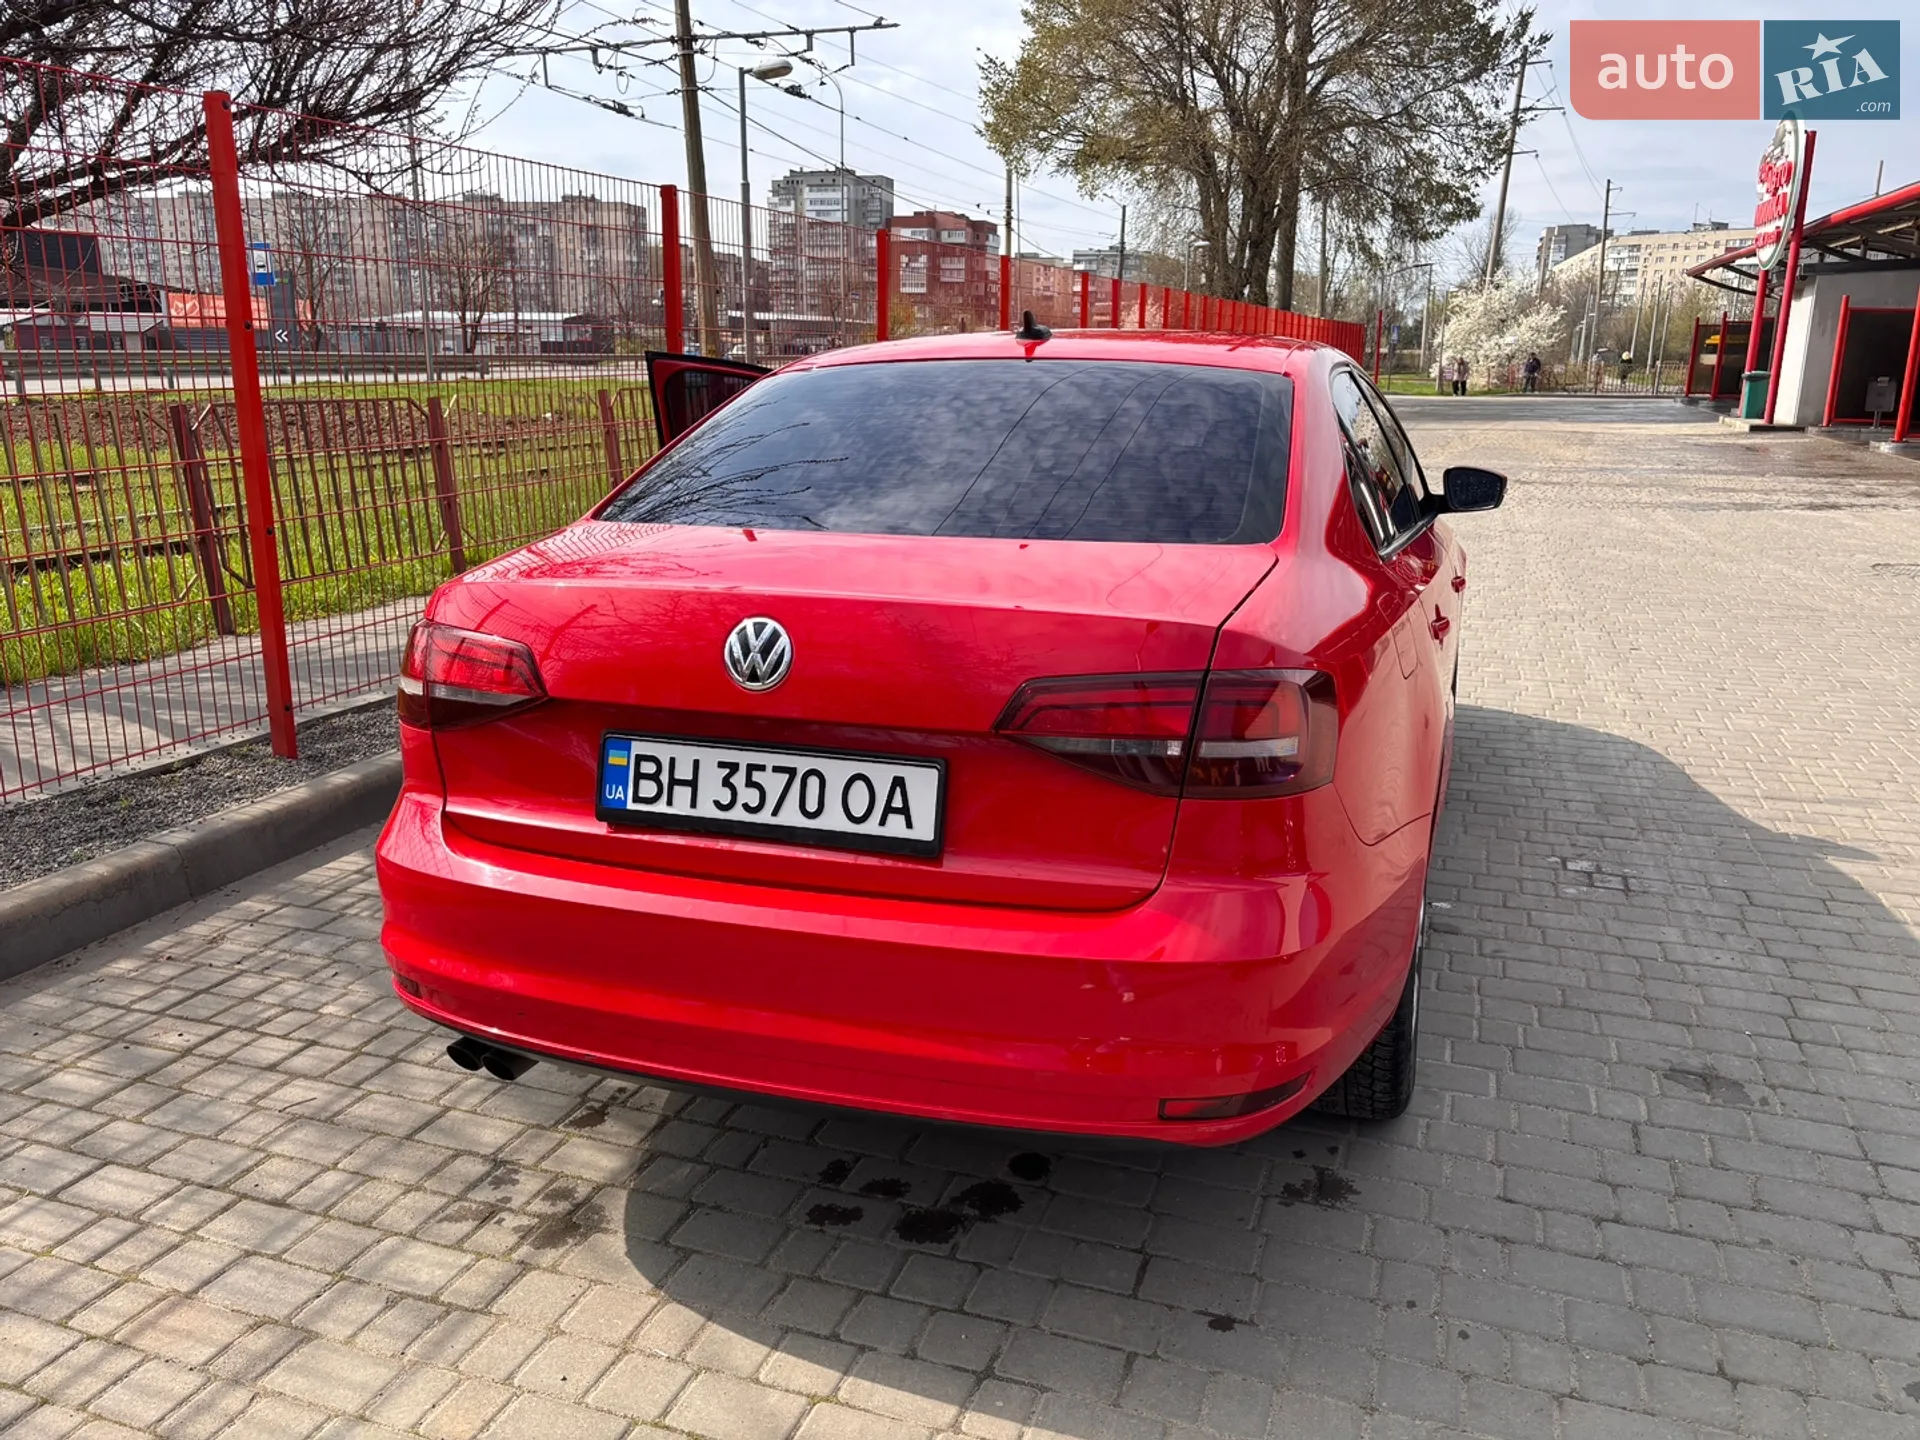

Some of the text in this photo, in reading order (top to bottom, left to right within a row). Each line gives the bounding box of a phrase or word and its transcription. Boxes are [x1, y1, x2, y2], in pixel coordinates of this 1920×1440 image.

[605, 784, 625, 801] UA
[632, 753, 914, 830] BH 3570 OA
